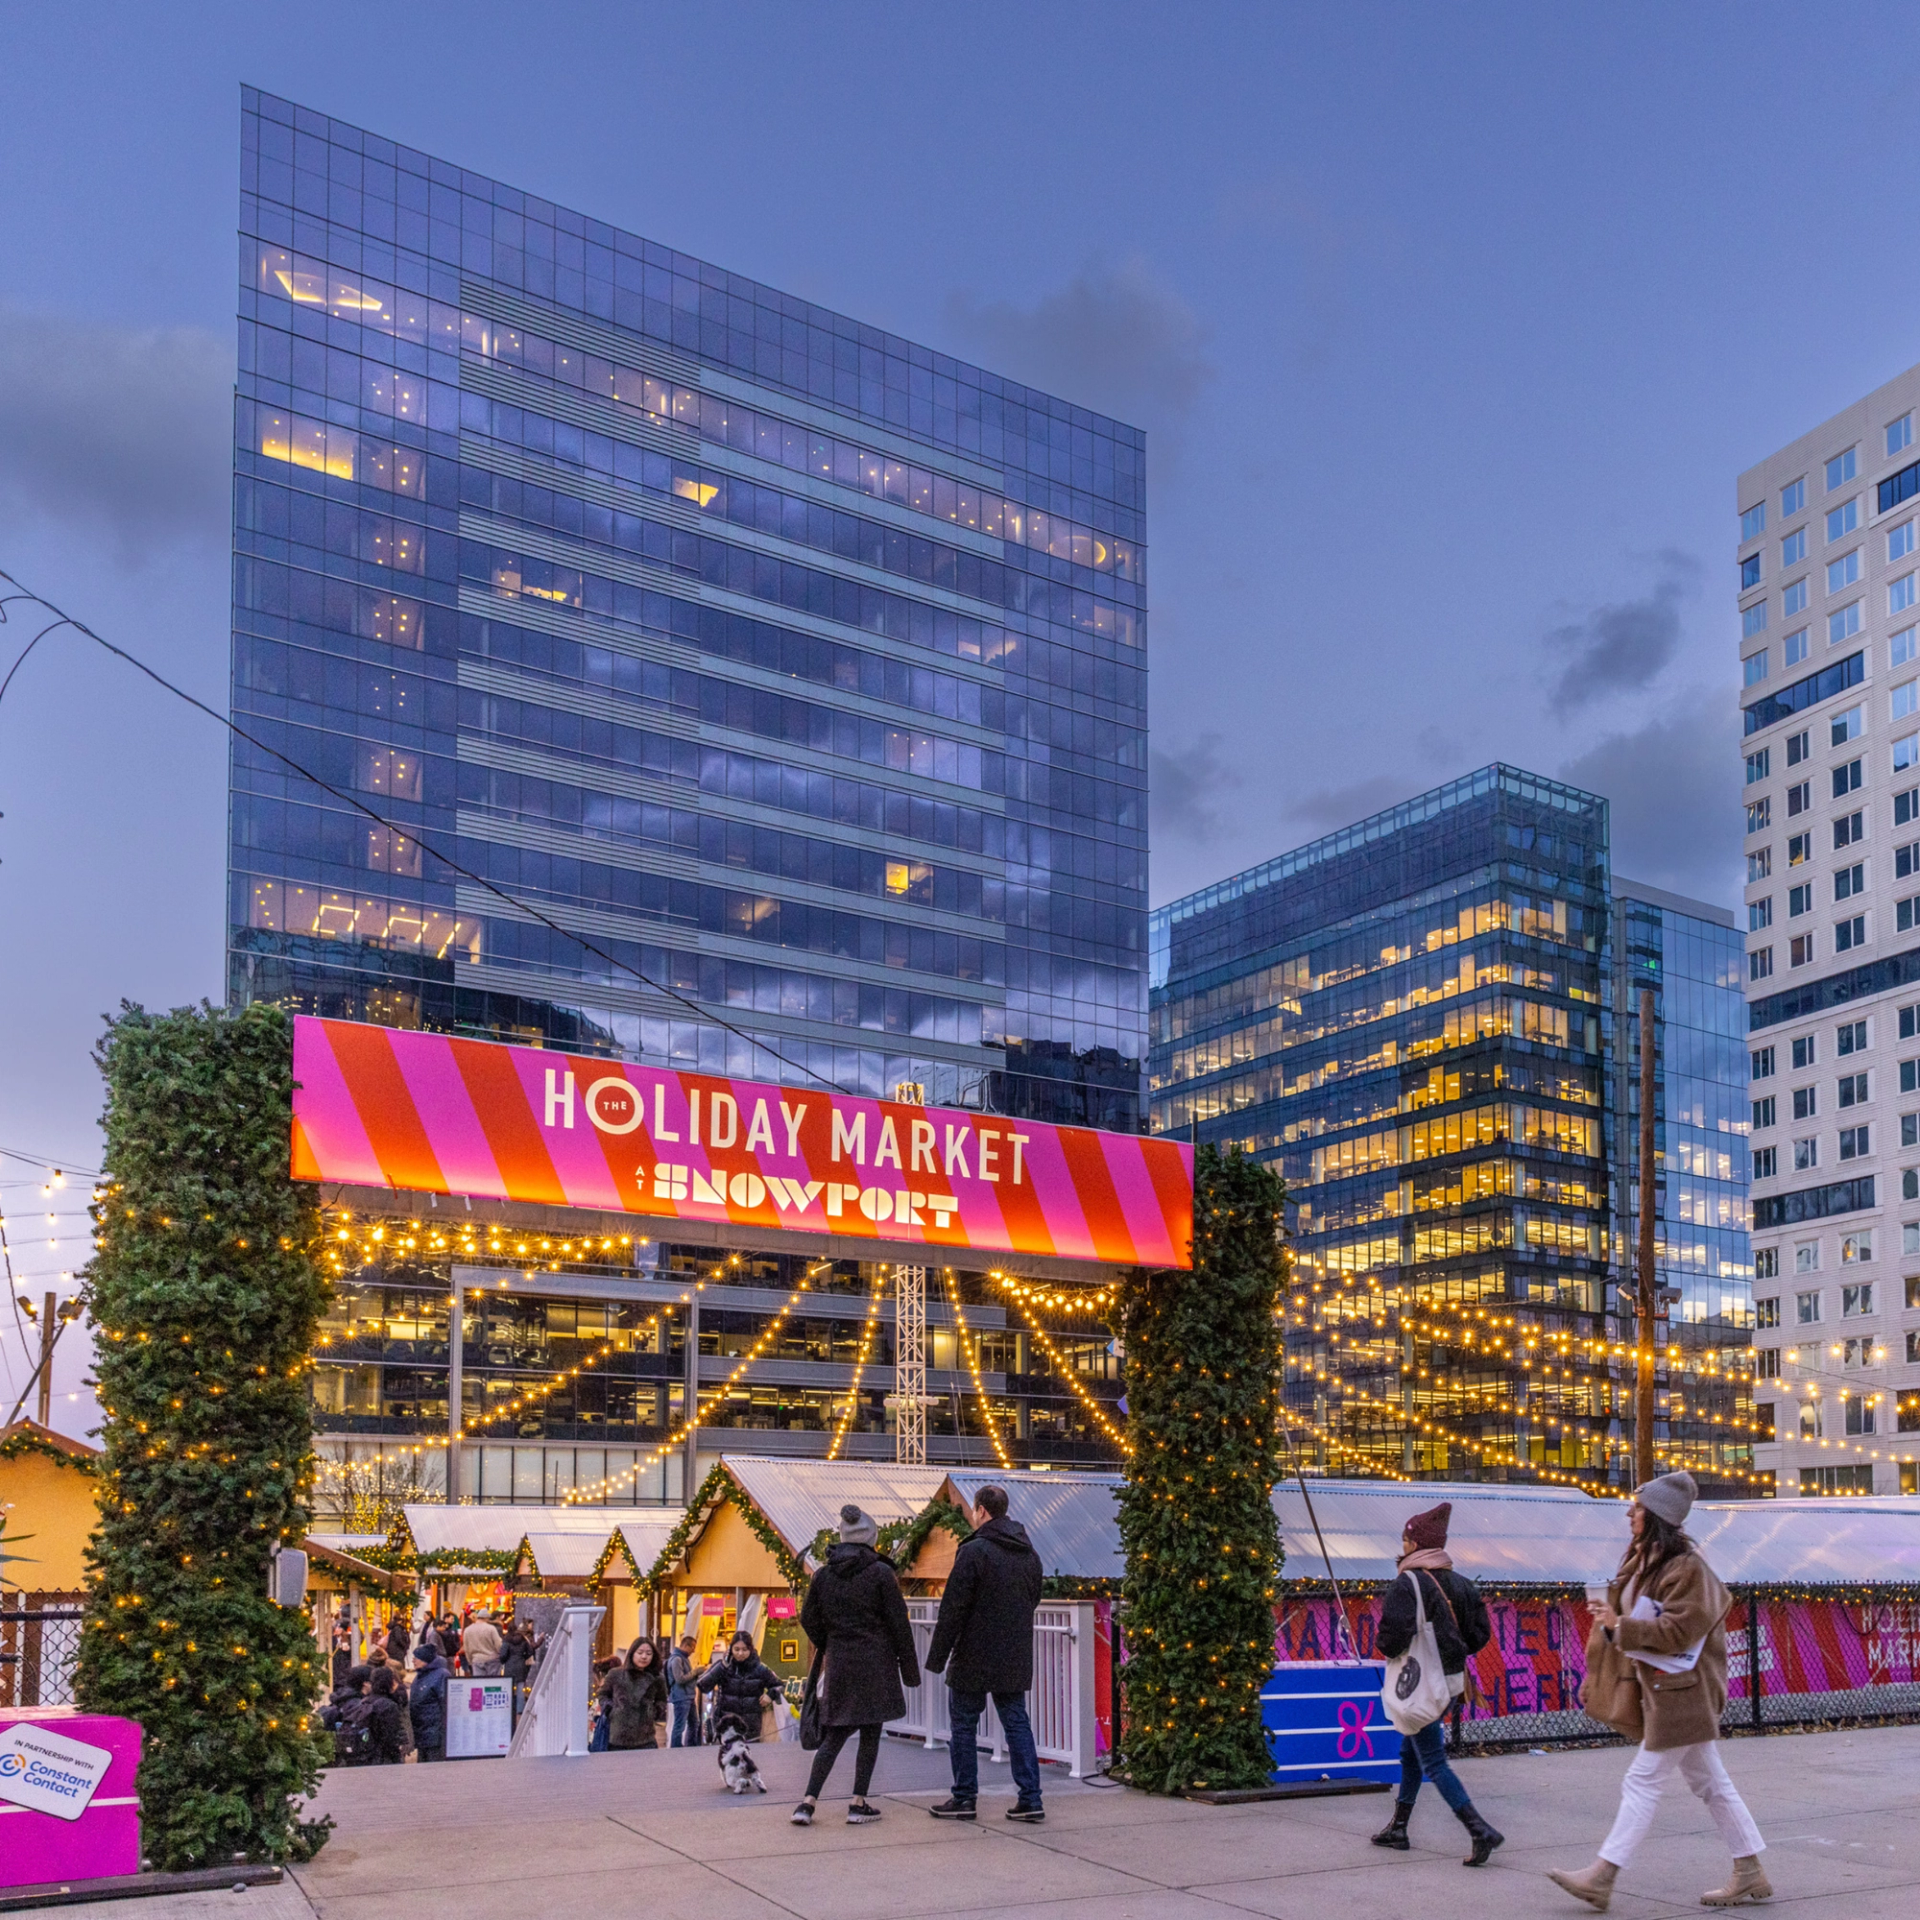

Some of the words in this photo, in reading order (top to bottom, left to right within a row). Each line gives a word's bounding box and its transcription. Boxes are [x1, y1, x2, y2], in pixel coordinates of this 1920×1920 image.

[603, 1100, 627, 1111] THE
[545, 1068, 807, 1157] HOLIDAY
[831, 1108, 1030, 1185] MARKET
[635, 1165, 645, 1190] AT
[654, 1162, 958, 1229] SNOWPORT
[1862, 1603, 1920, 1632] HOLI
[14, 1739, 23, 1747] IN
[24, 1742, 74, 1763] PARTNERSHIP
[74, 1759, 94, 1770] WITH
[23, 1772, 79, 1798] Contact
[30, 1761, 93, 1789] Constant
